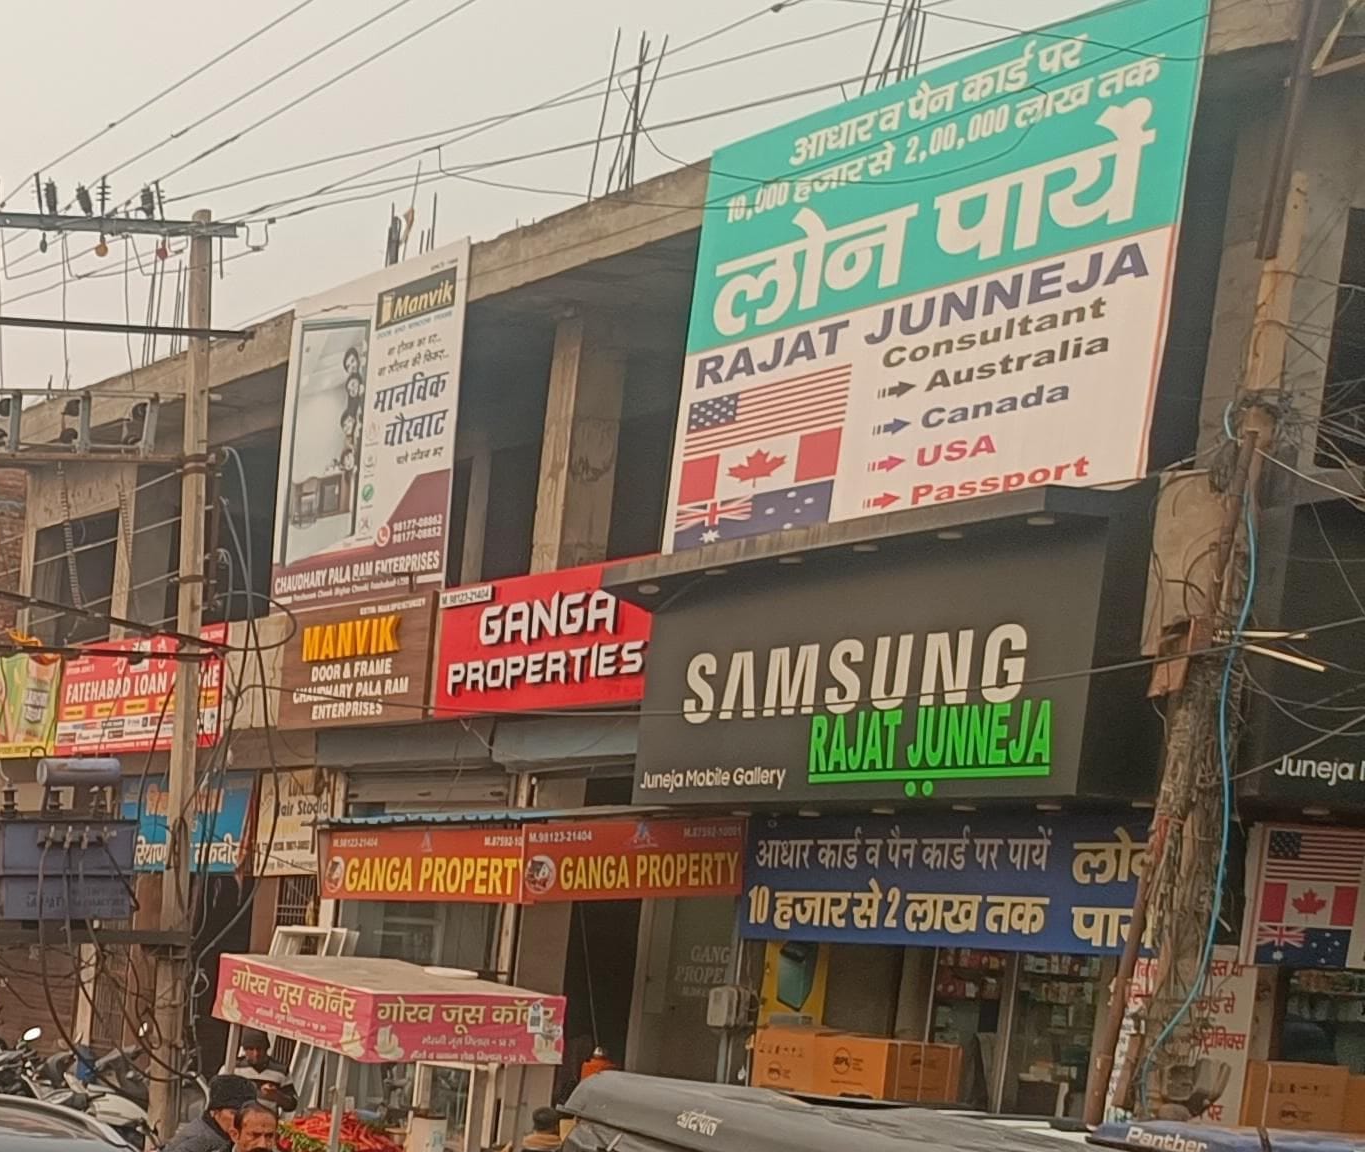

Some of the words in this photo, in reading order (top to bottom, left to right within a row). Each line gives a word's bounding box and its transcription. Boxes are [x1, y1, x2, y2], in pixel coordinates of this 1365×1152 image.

[789, 112, 874, 166] आधार
[874, 101, 904, 136] व
[908, 80, 957, 123] पैन
[962, 40, 1037, 101] कार्ड
[1038, 33, 1089, 70] पर
[726, 180, 789, 223] 10,000
[793, 157, 868, 204] हजार
[868, 140, 894, 175] से
[905, 105, 1009, 166] 2,00,000
[1015, 76, 1095, 126] लाख
[1097, 53, 1166, 98] तक
[711, 203, 919, 337] लोन
[393, 280, 454, 319] Manvik
[694, 320, 851, 390] RAJAT
[863, 242, 1150, 346] JUNNEJA
[881, 296, 1109, 369] Consultant
[924, 332, 1111, 393] Australia
[373, 371, 450, 413] मानविक
[920, 381, 1071, 431] Canada
[915, 433, 997, 470] USA
[909, 455, 1092, 509] Passport
[274, 571, 327, 595] CHAUDHARY
[328, 566, 351, 585] PALA
[351, 561, 374, 580] RAM
[374, 550, 441, 576] ENTERPRISES
[301, 614, 401, 662] MANVIK
[479, 587, 618, 647] GANGA
[65, 678, 131, 705] FATEHABAD
[133, 671, 168, 697] LOAN
[292, 683, 354, 705] CHAUDHARY
[355, 680, 382, 698] PALA
[384, 676, 409, 694] RAM
[311, 664, 340, 683] DOOR
[342, 663, 352, 679] &
[353, 657, 393, 677] FRAME
[447, 639, 647, 697] PROPERTIES
[682, 622, 1029, 725] SAMSUNG
[311, 699, 384, 721] ENTERPRISES
[808, 708, 902, 774] RAJAT
[906, 699, 1053, 768] JUNNEJA
[640, 770, 684, 792] Juneja
[686, 767, 731, 788] Mobile
[733, 766, 787, 791] Gallery
[1274, 754, 1356, 786] Juneja
[559, 854, 630, 891] GANGA
[635, 851, 740, 889] PROPERTY
[755, 838, 815, 870] आधार
[818, 826, 863, 868] कार्ड
[865, 839, 882, 866] व
[886, 827, 915, 868] पैन
[922, 826, 969, 869] कार्ड
[974, 838, 1006, 868] पर
[1008, 828, 1054, 871] पायें
[344, 856, 413, 893] GANGA
[418, 857, 523, 896] PROPERT
[747, 885, 769, 926] 10
[774, 892, 852, 930] हजार
[851, 878, 885, 929] से
[887, 885, 900, 928] 2
[904, 893, 983, 933] लाख
[985, 896, 1050, 934] तक
[675, 965, 725, 985] PROPE
[691, 945, 730, 964] GANG
[232, 965, 270, 998] गोरव
[273, 977, 305, 1017] जूस
[308, 982, 357, 1021] कॉर्नर
[377, 996, 436, 1022] गोरव
[442, 1002, 488, 1035] जूस
